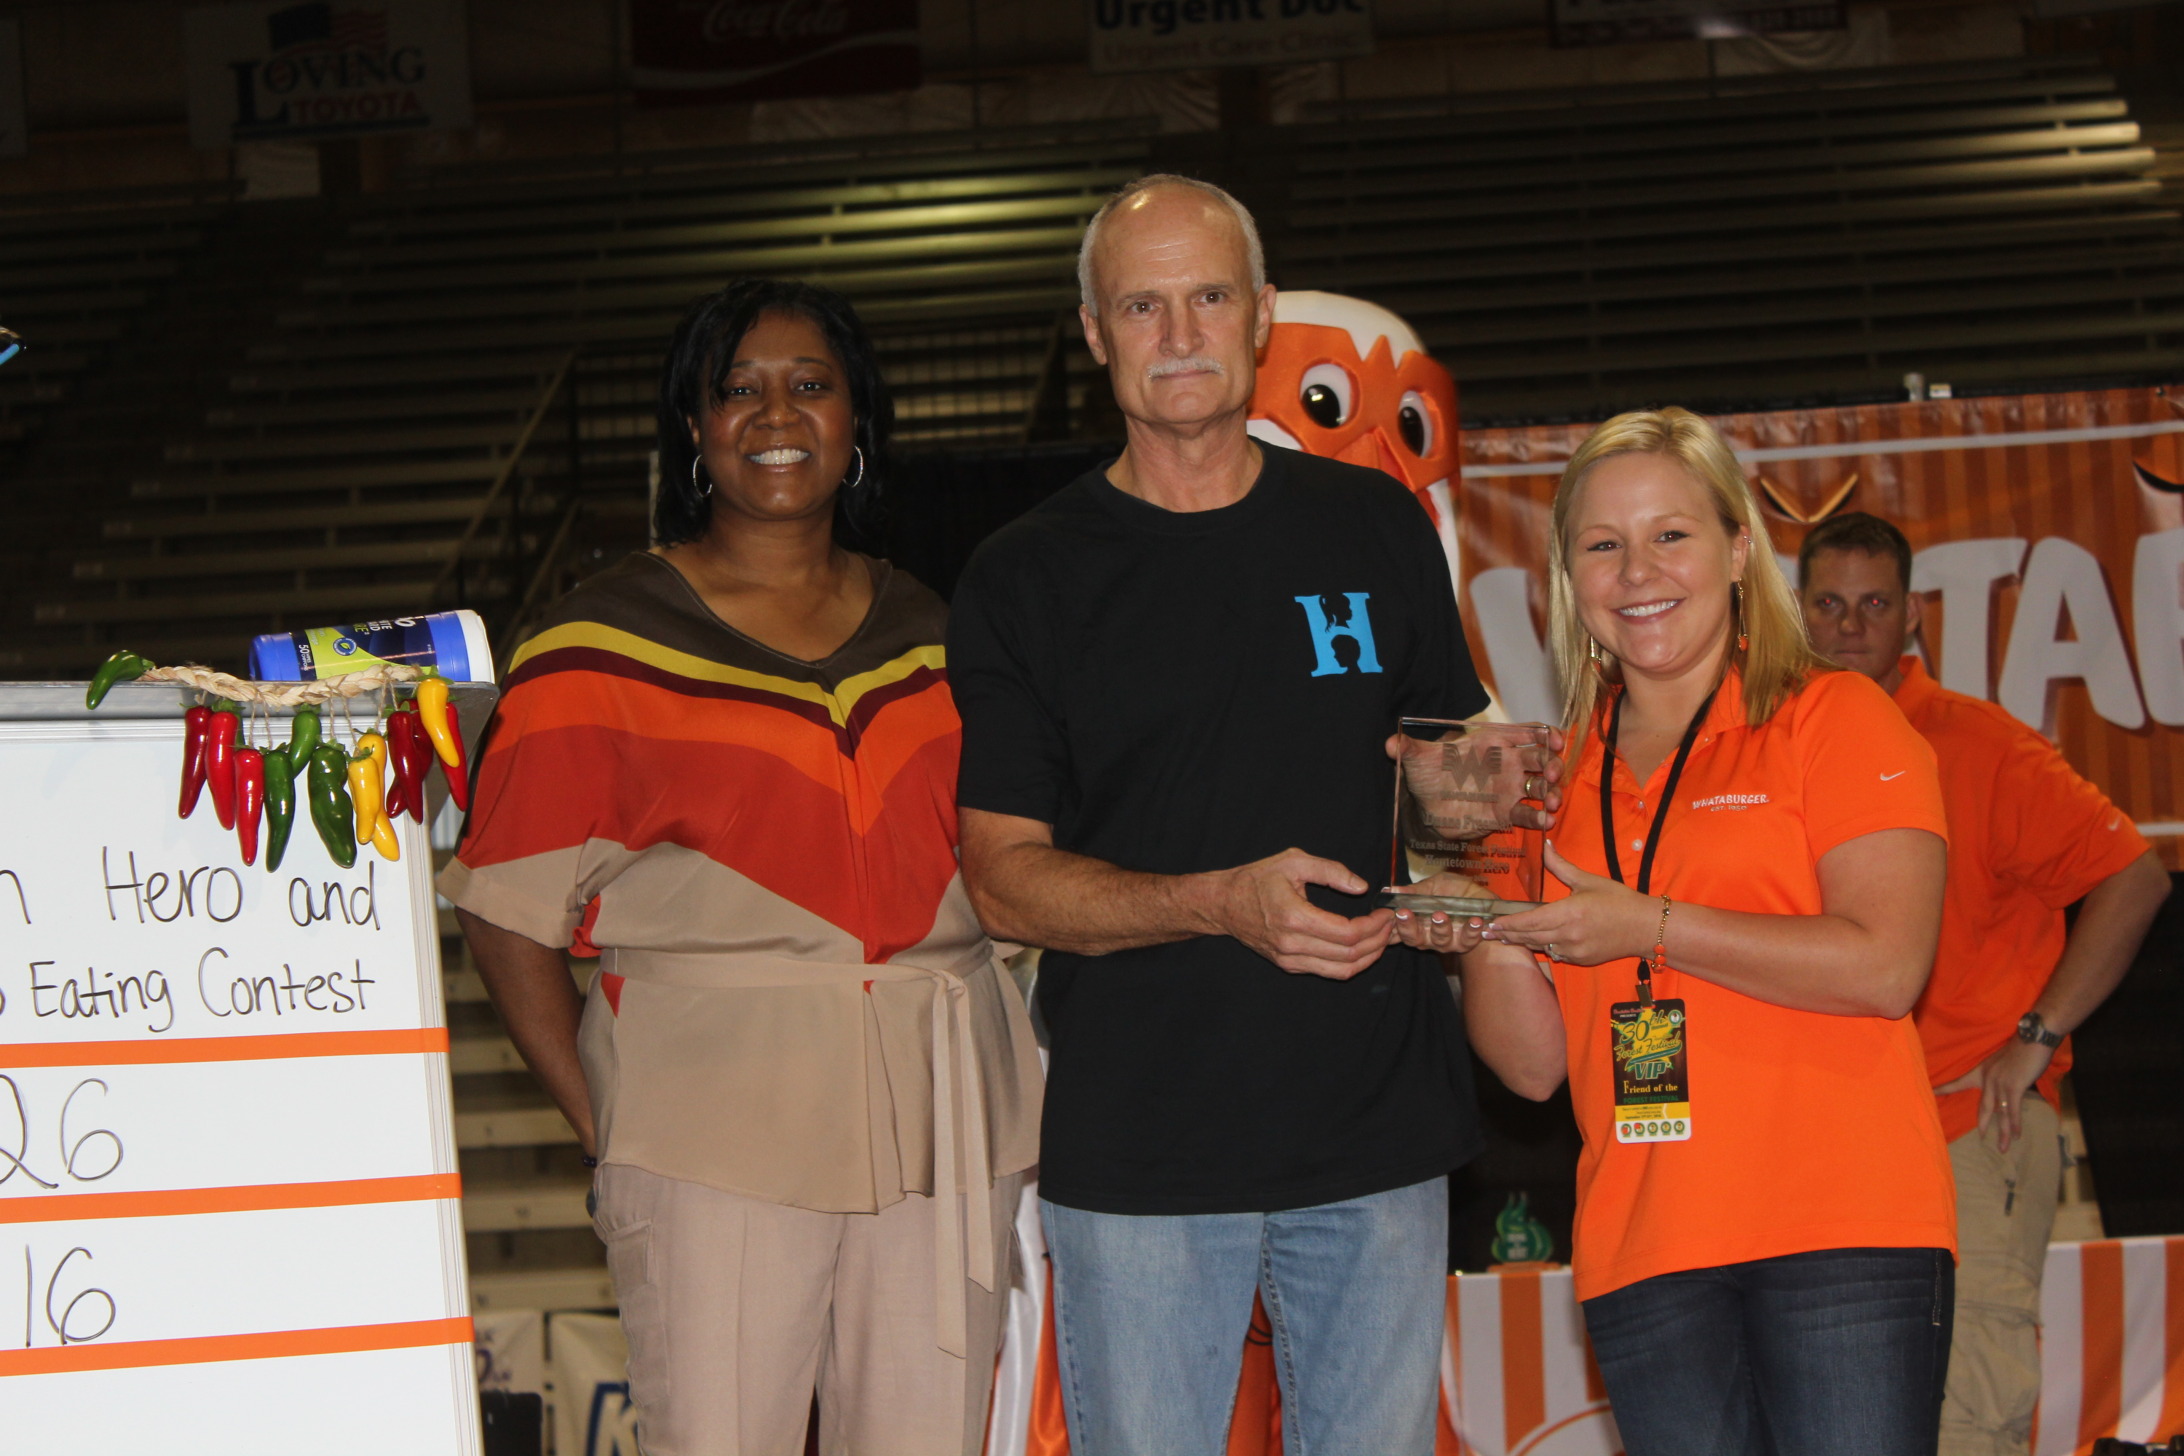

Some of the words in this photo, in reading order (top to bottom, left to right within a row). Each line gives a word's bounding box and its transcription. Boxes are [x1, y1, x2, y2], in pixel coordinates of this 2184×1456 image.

[1096, 0, 1264, 35] Urgent
[229, 46, 426, 128] LOVING
[293, 89, 422, 124] TOYOTA
[298, 644, 310, 654] 50
[1294, 592, 1383, 677] H
[1410, 838, 1436, 851] Texas
[1437, 840, 1460, 852] State
[103, 846, 243, 924] Hero
[288, 860, 381, 931] and
[29, 960, 174, 1033] Eating
[198, 946, 376, 1017] Contest
[1623, 1080, 1650, 1094] Friend
[1653, 1084, 1663, 1093] of
[1665, 1083, 1678, 1092] the
[1634, 1061, 1667, 1080] VIP
